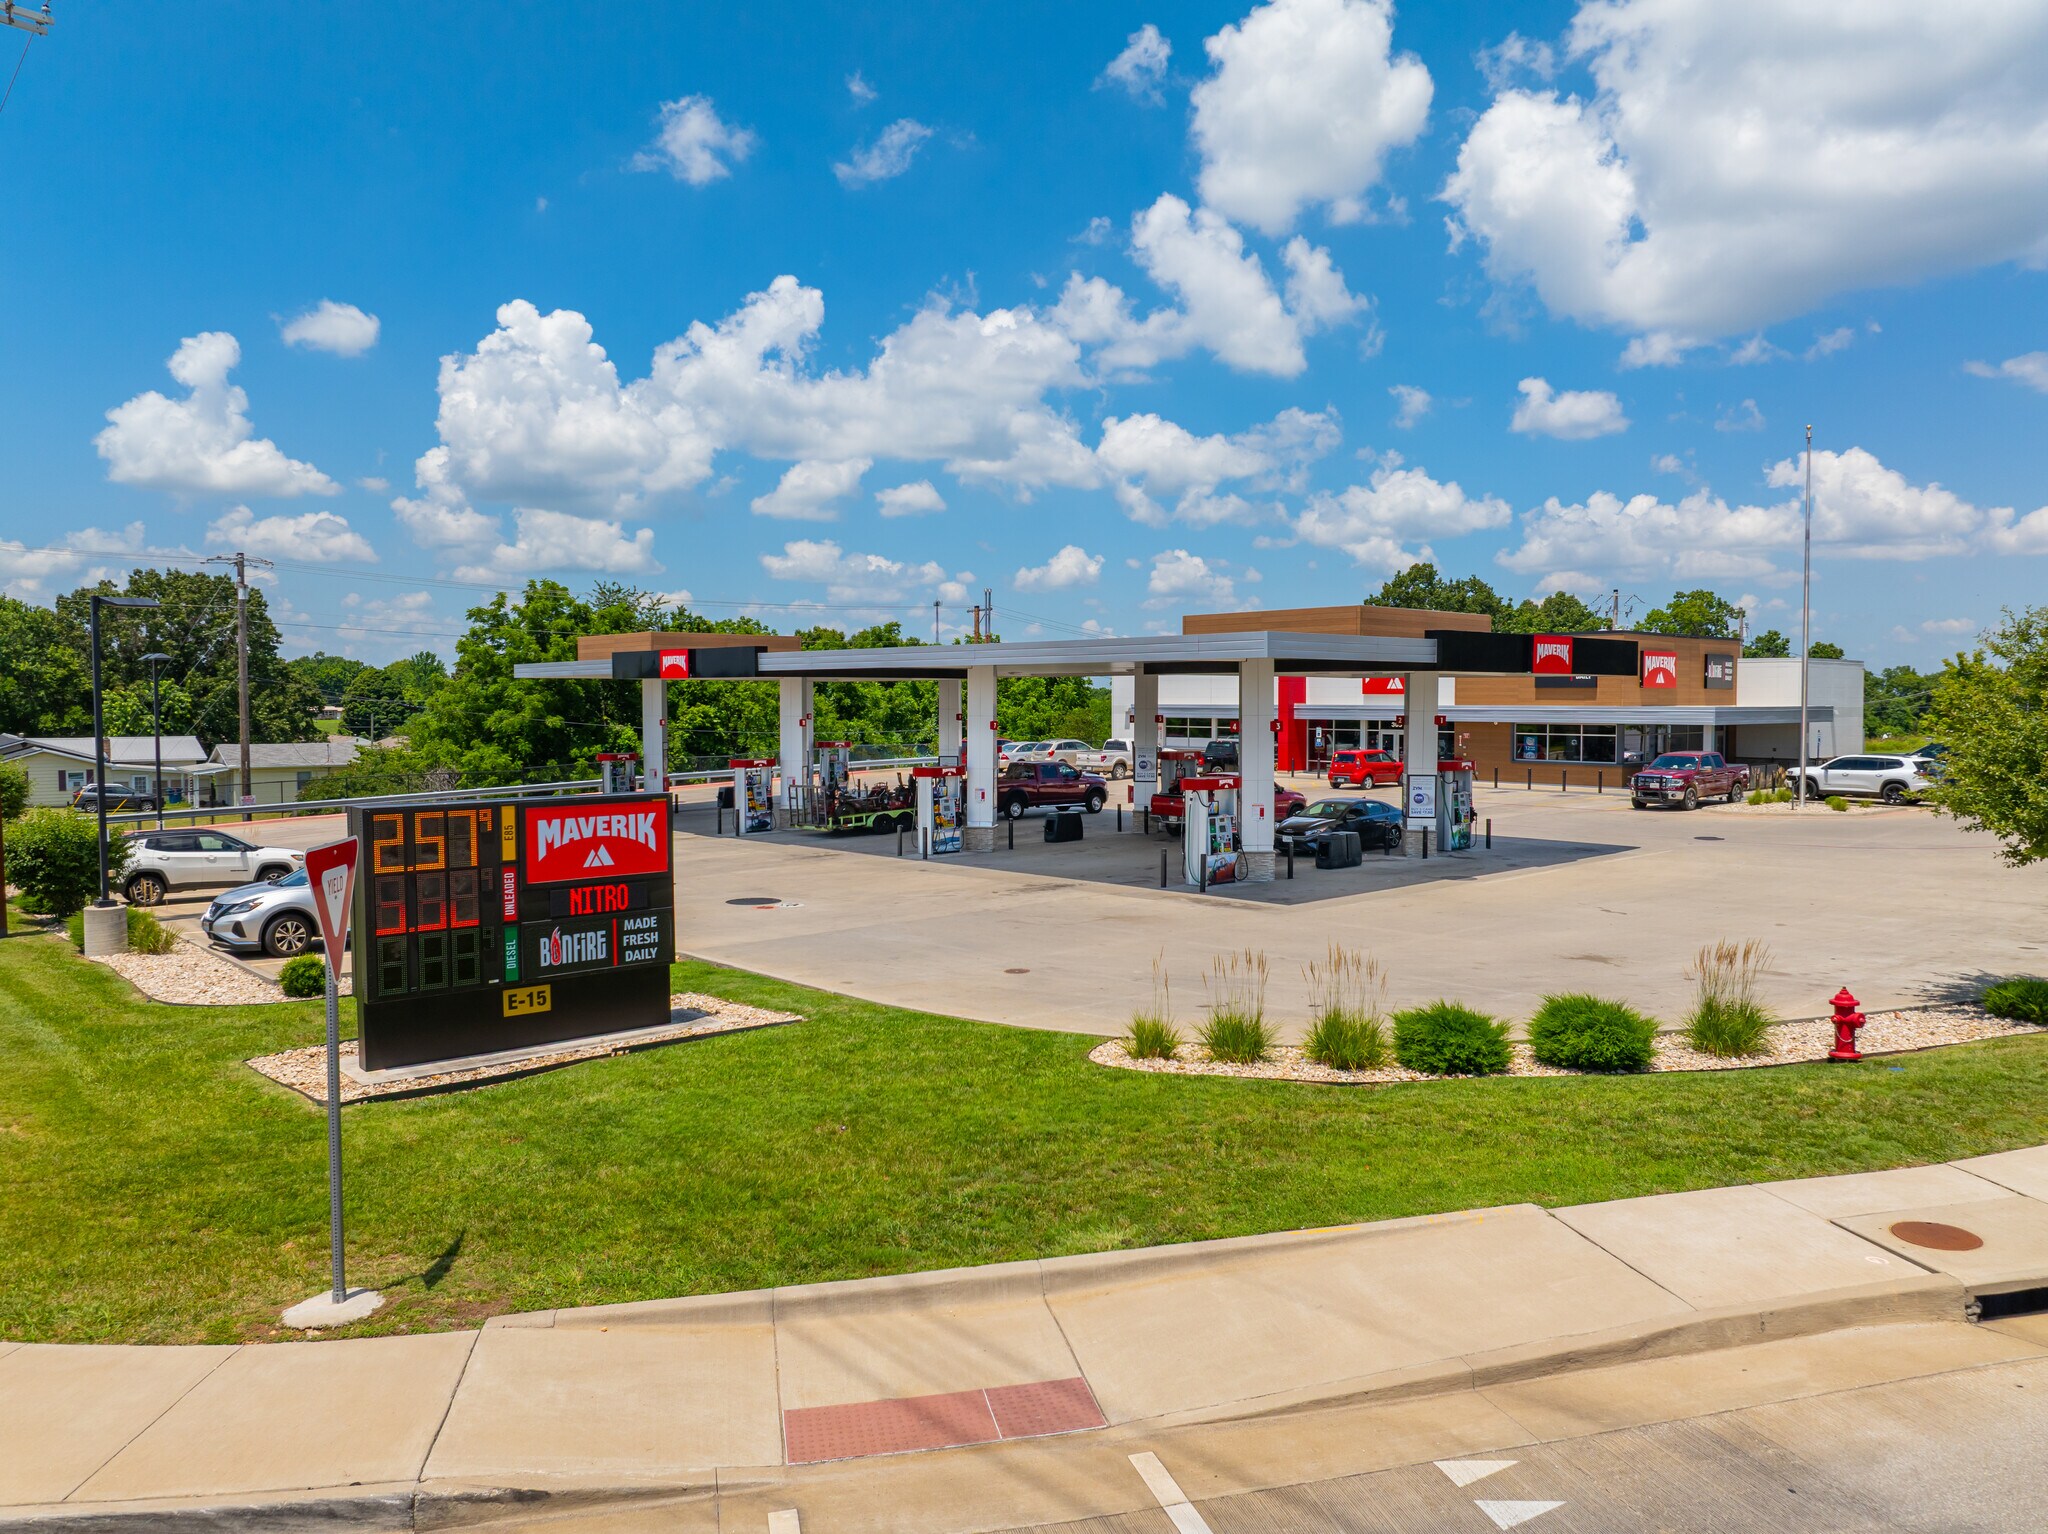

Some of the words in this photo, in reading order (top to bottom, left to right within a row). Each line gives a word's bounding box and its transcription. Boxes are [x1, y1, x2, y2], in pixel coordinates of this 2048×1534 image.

[662, 655, 687, 672] MAVERIK
[1536, 643, 1569, 665] MAVERIK
[1644, 655, 1676, 679] MAVERIK
[1275, 722, 1281, 730] 3
[503, 824, 514, 841] E85
[537, 812, 657, 862] MAVERIK
[327, 875, 344, 896] YIELD
[504, 872, 515, 916] UNLEADED
[569, 883, 629, 916] NITRO
[623, 916, 658, 931] MADE
[623, 932, 659, 947] FRESH
[506, 939, 517, 969] DIESEL
[625, 947, 658, 962] DAILY
[507, 990, 547, 1011] E-15
